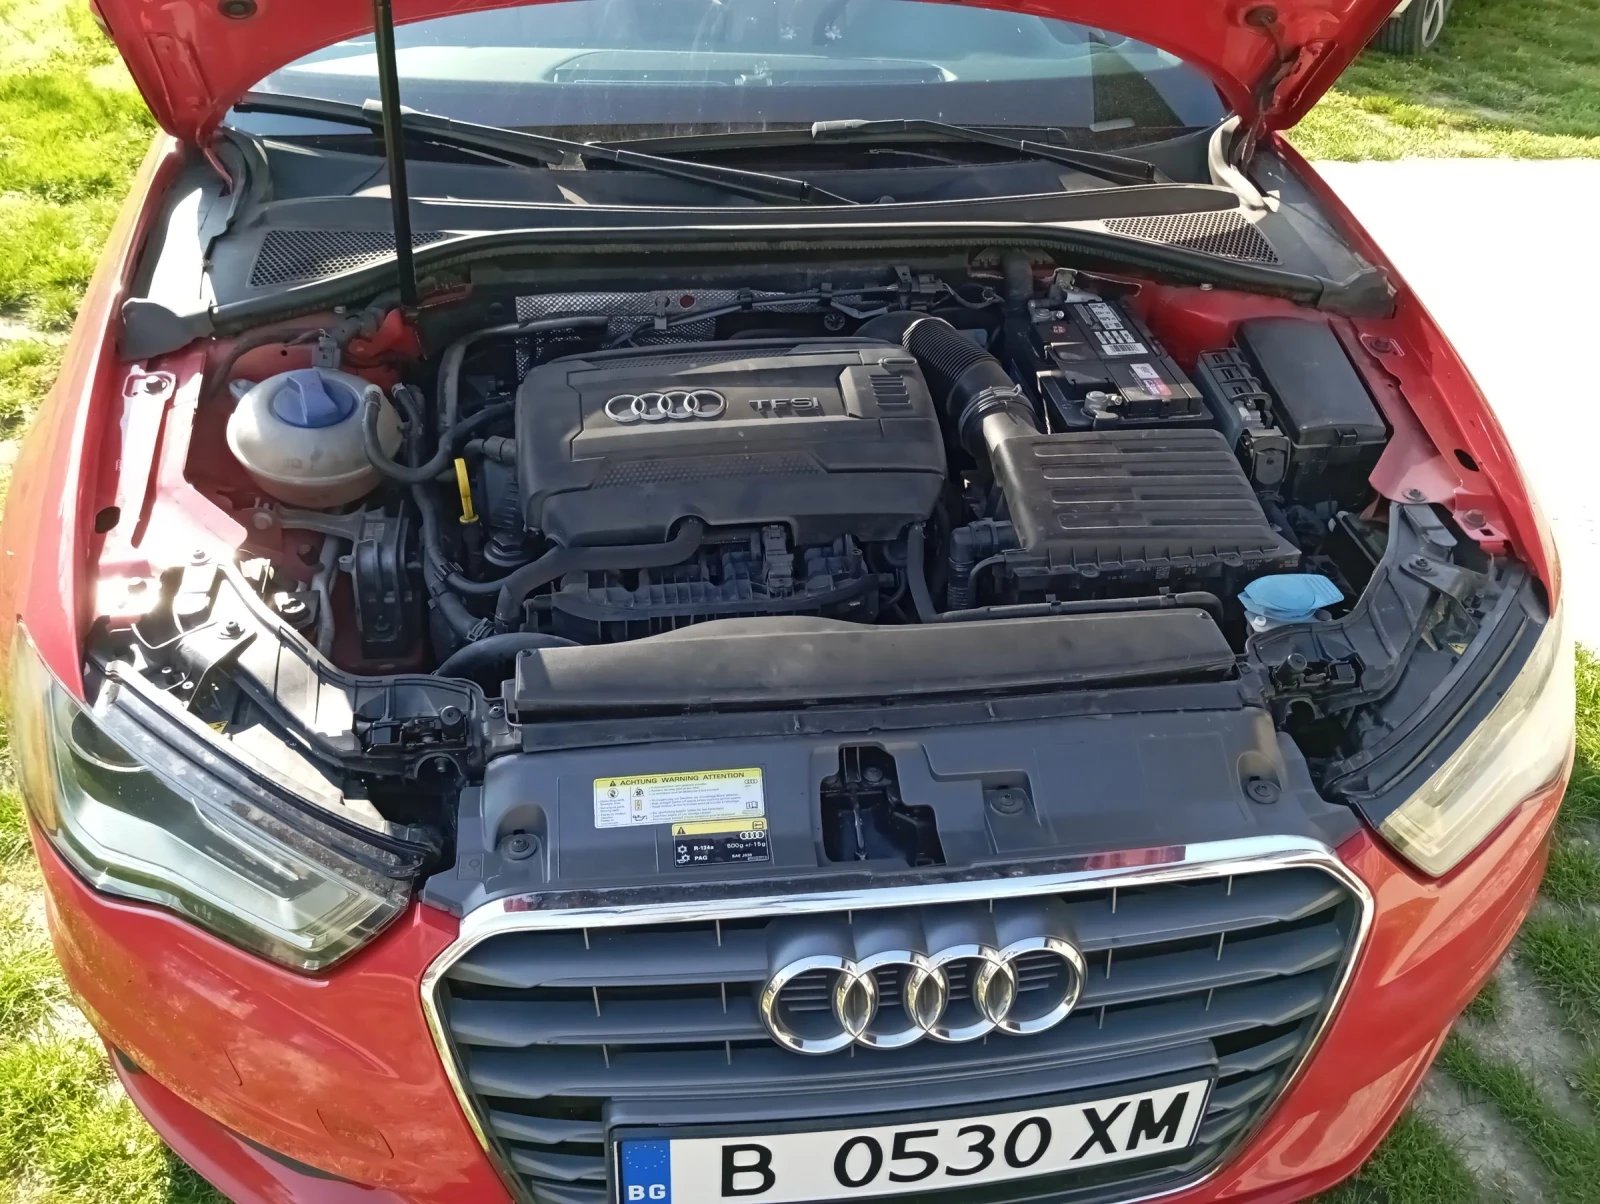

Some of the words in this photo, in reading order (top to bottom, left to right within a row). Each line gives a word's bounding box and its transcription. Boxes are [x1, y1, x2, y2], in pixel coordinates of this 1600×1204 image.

[748, 396, 821, 411] TFSI
[620, 778, 657, 786] ACHTUNG
[661, 775, 699, 783] WARNING
[702, 772, 745, 780] ATTENTION
[720, 1143, 777, 1197] B
[833, 1116, 1053, 1188] 0530
[1070, 1091, 1190, 1161] XM
[628, 1184, 666, 1201] BG
